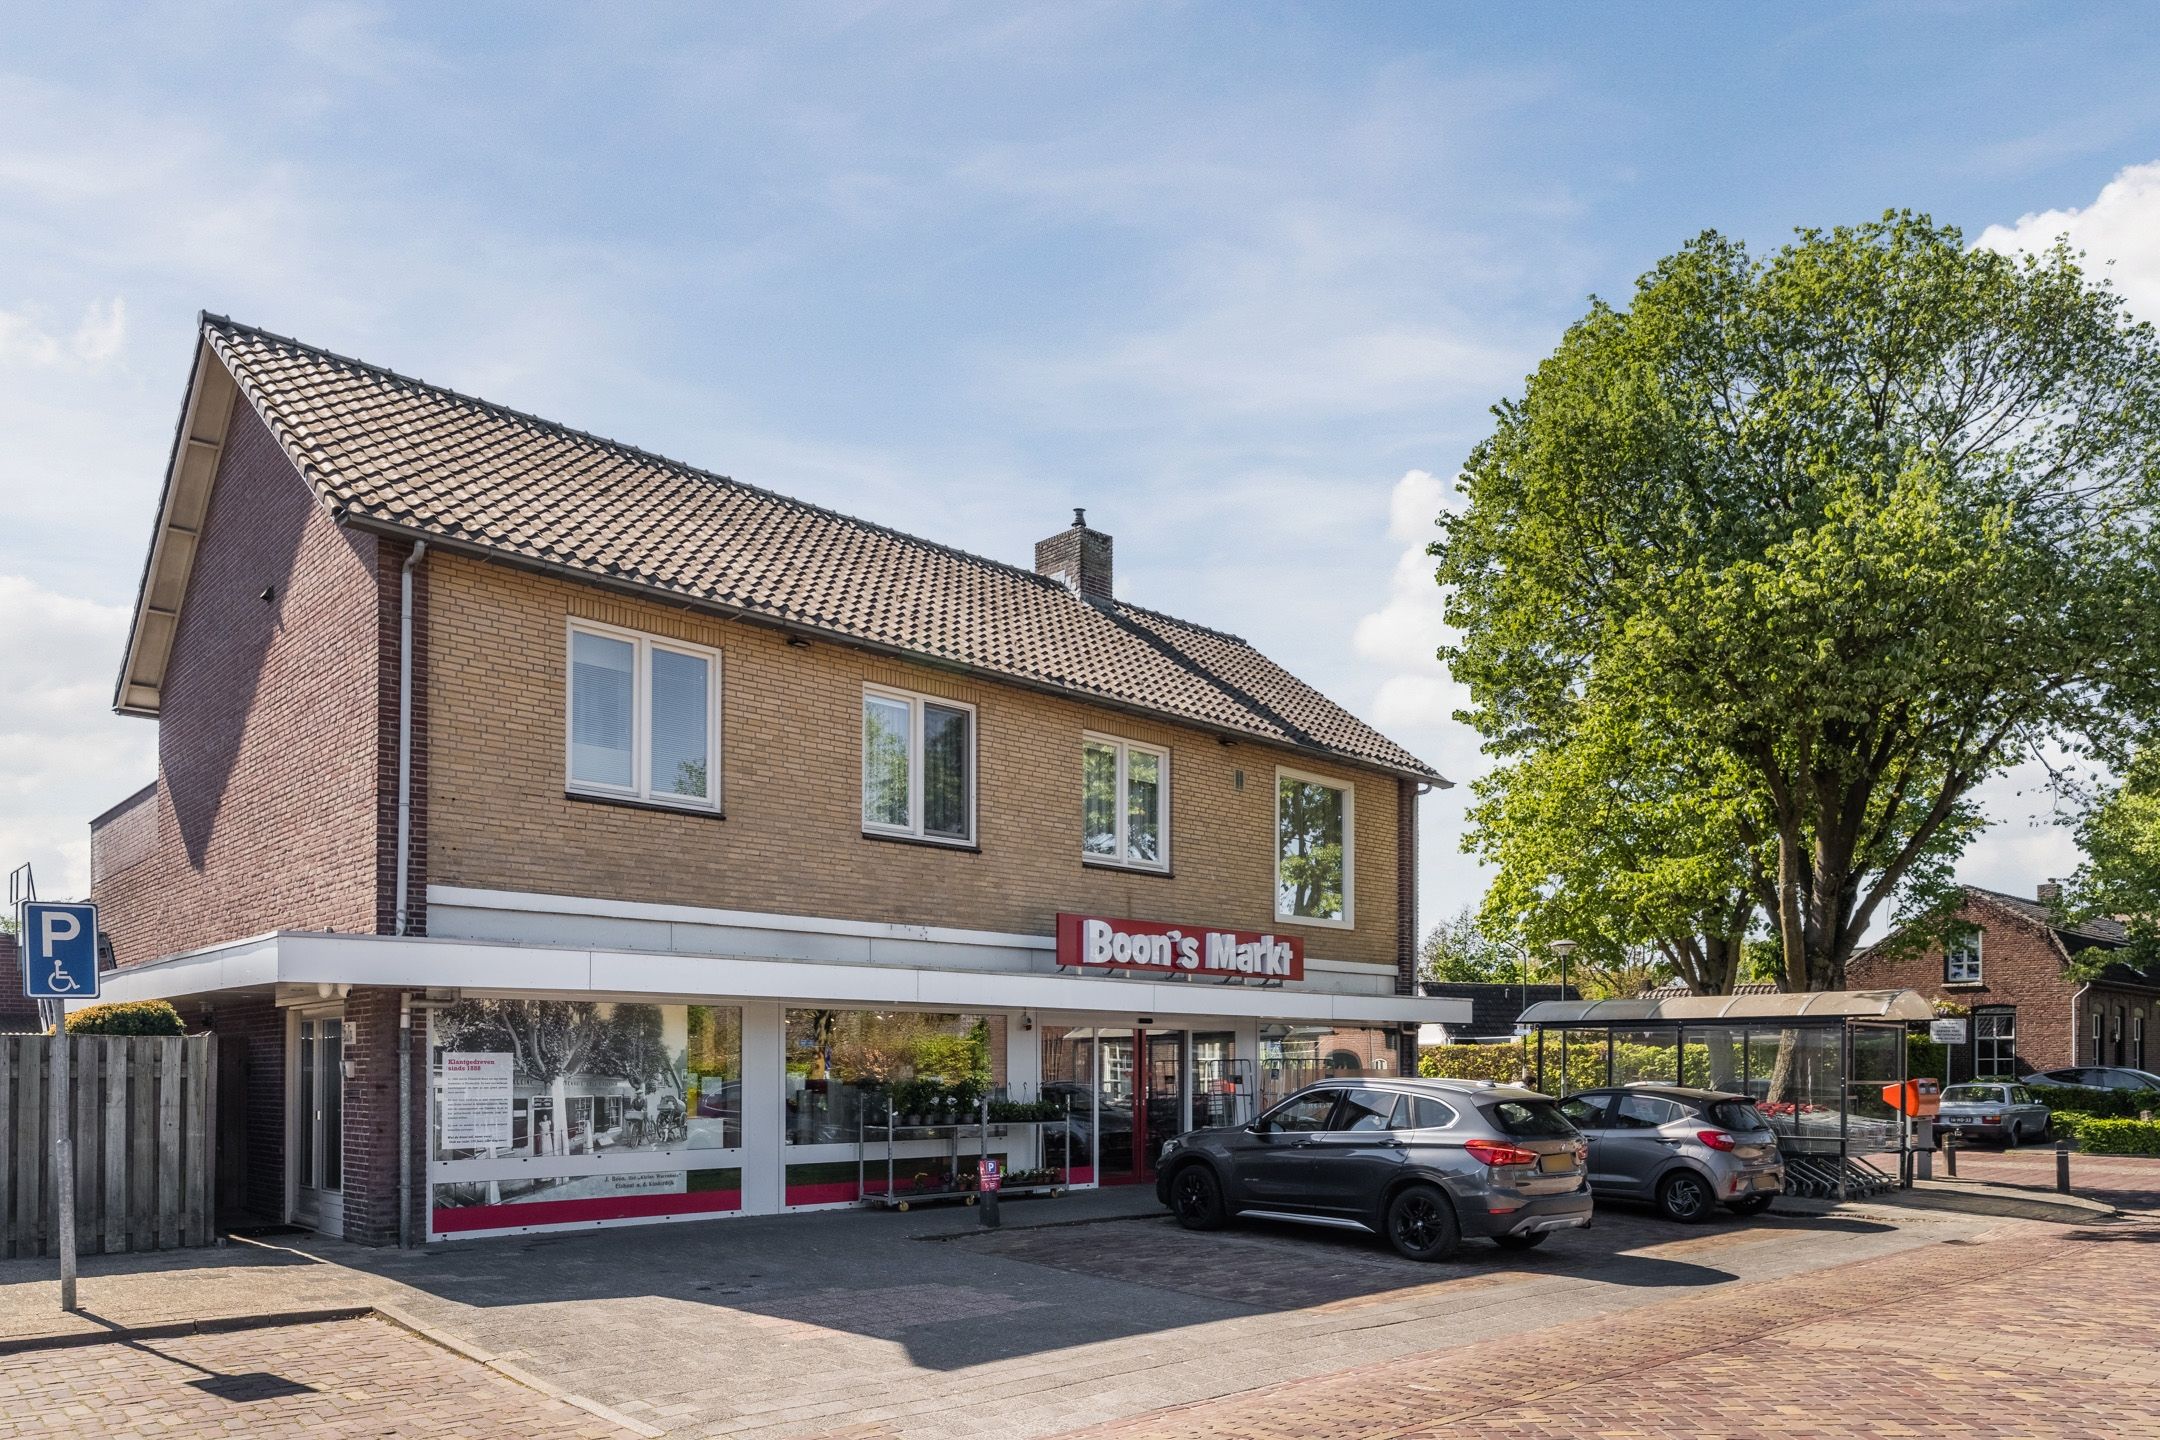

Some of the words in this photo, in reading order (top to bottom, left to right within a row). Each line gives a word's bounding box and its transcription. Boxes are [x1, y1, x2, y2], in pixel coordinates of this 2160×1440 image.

[41, 911, 81, 957] P
[1083, 919, 1199, 969] Boon's
[1205, 932, 1293, 976] Markt
[988, 1162, 994, 1171] P
